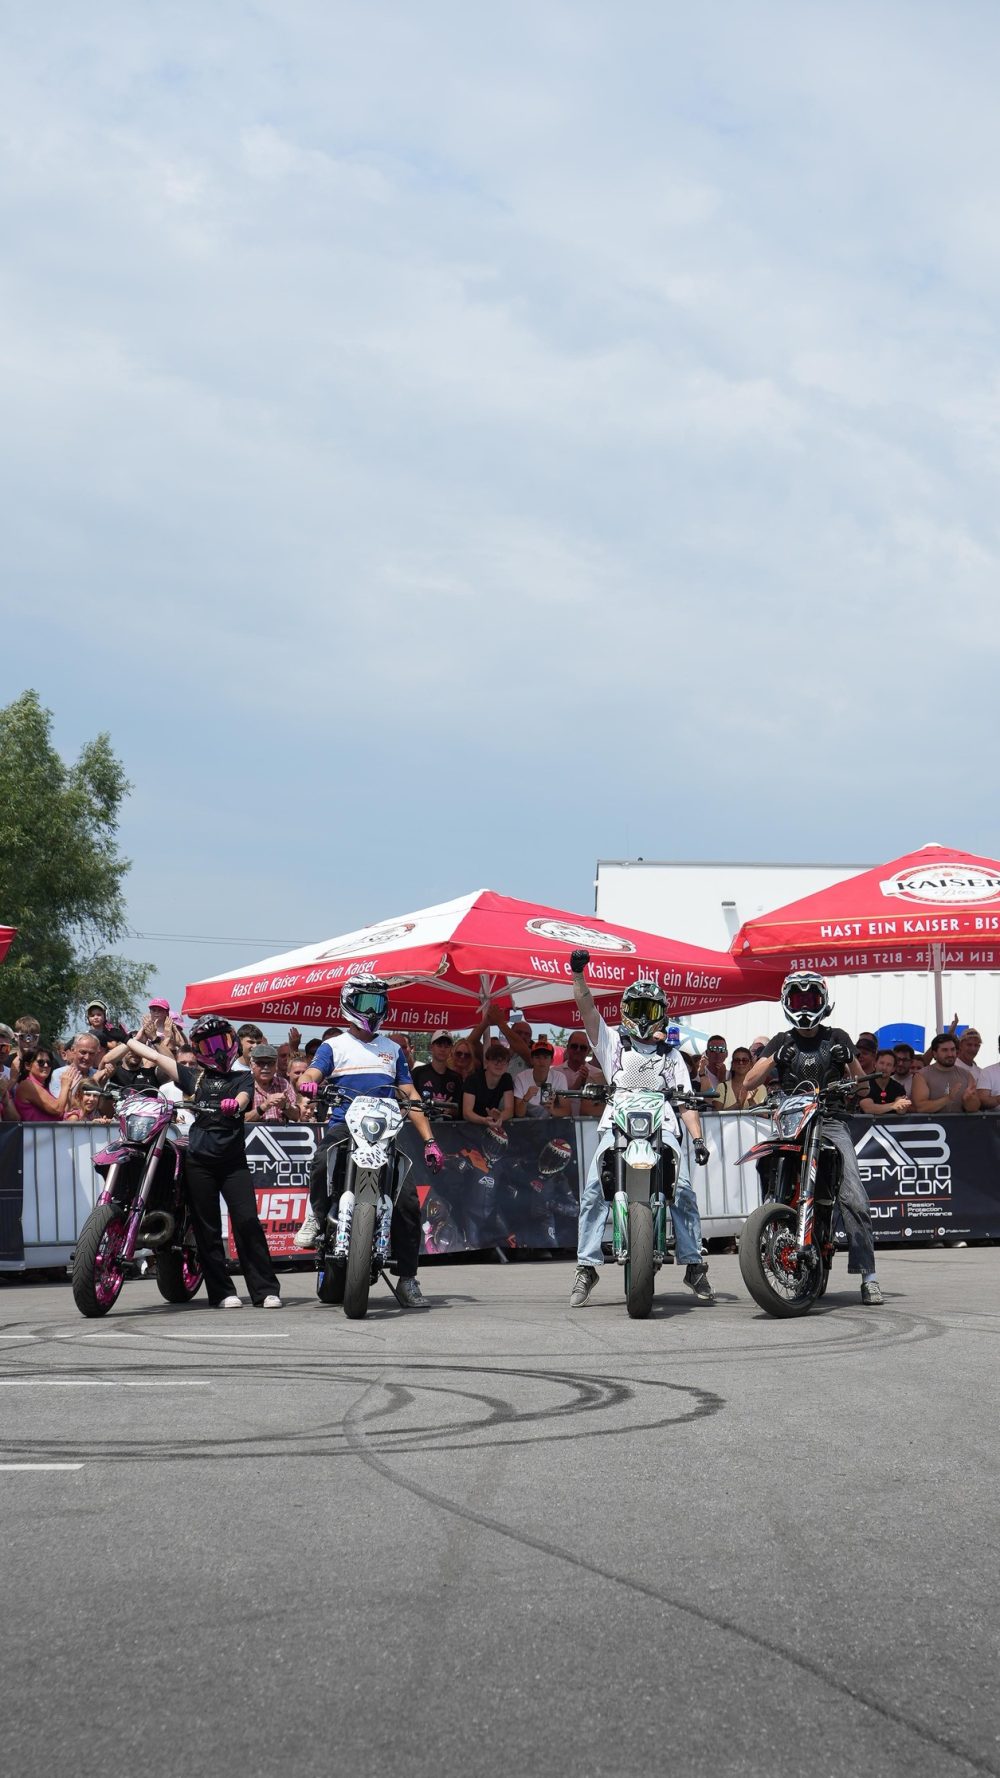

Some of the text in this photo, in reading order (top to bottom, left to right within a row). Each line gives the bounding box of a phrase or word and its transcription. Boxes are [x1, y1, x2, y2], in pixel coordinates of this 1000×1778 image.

[897, 879, 1000, 890] KAISER
[820, 923, 862, 938] HAST
[868, 921, 896, 935] EIN
[903, 918, 960, 933] KAISER
[231, 983, 252, 998] Hast
[254, 979, 268, 992] ein
[270, 975, 299, 991] Kaiser
[326, 966, 343, 979] ein
[347, 959, 379, 975] Kaiser
[530, 955, 560, 975] Hast
[588, 961, 626, 981] Kaiser
[637, 964, 660, 986] bist
[663, 969, 682, 987] ein
[685, 971, 722, 990] Kaiser
[859, 1164, 952, 1182] B-MOTO
[894, 1179, 952, 1196] .COM
